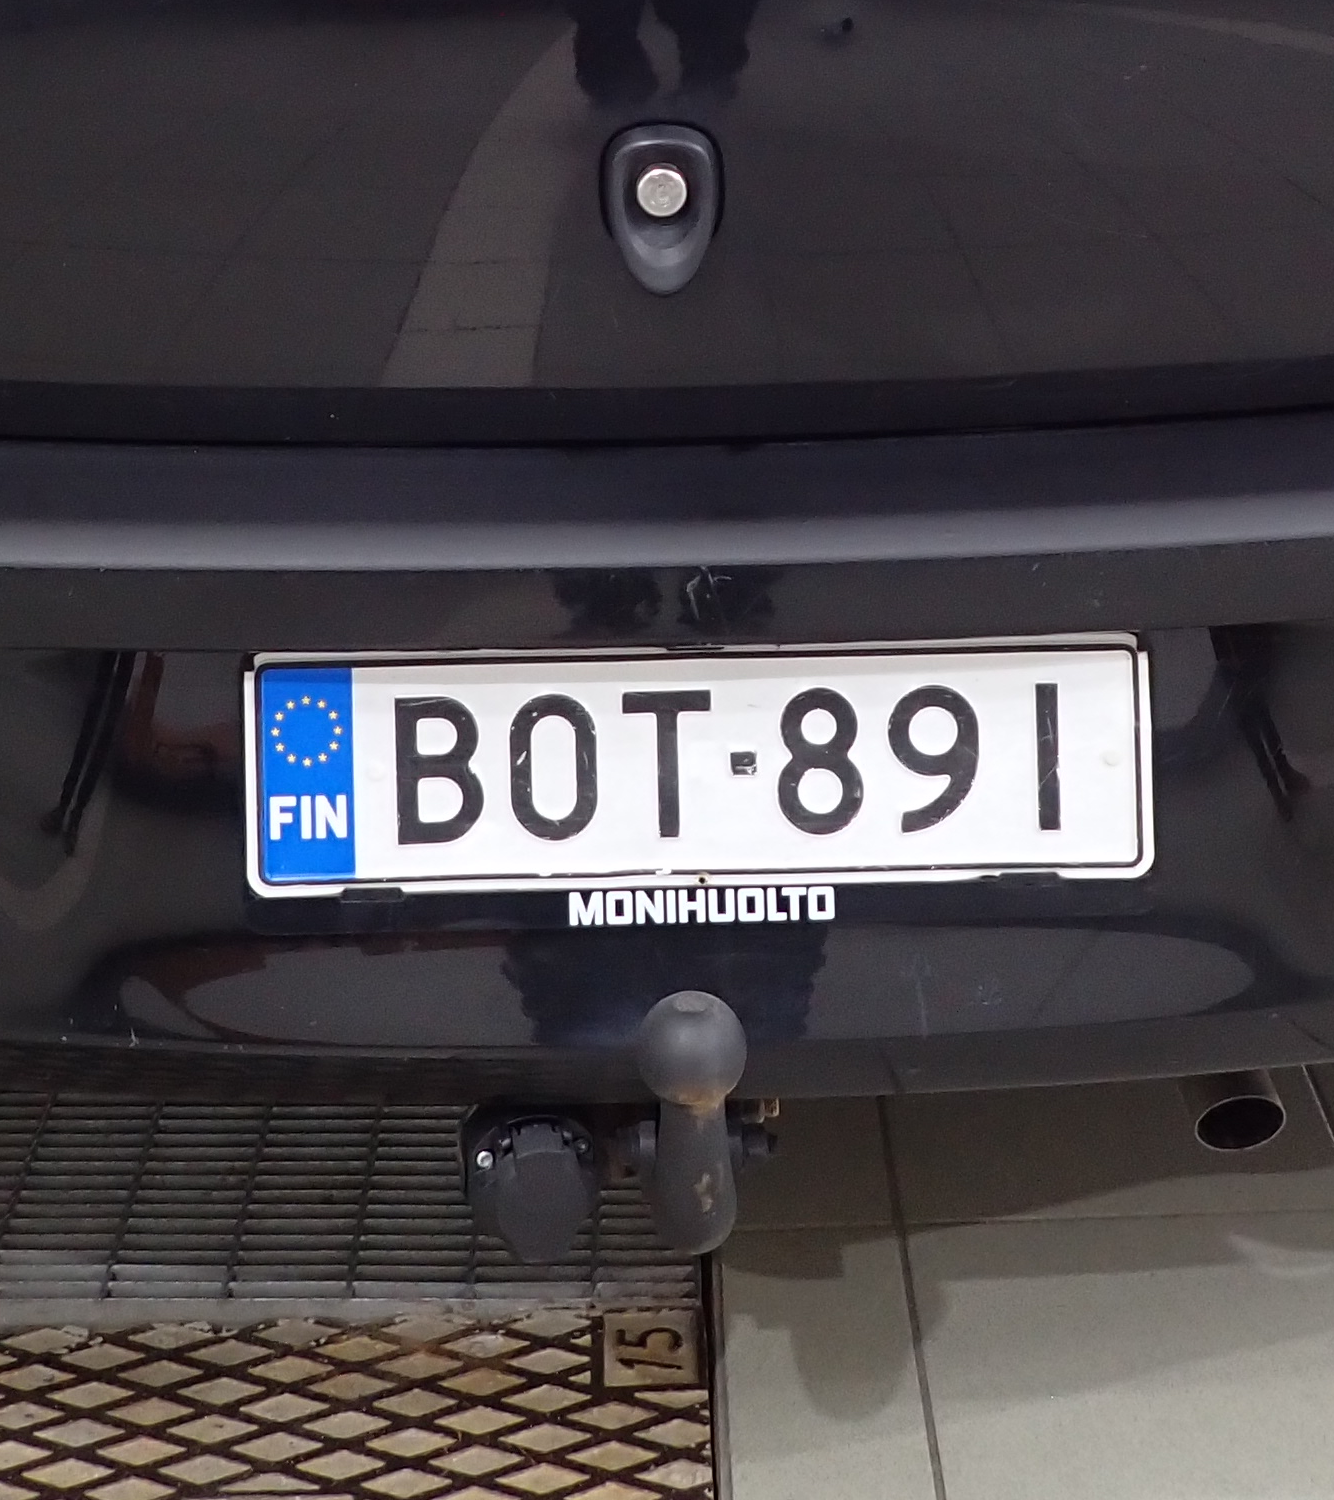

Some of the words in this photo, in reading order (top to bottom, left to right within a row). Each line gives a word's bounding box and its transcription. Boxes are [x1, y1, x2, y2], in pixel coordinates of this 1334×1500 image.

[394, 683, 1061, 846] BOT-891
[269, 794, 348, 841] FIN
[568, 885, 835, 927] MONIHUOLTO
